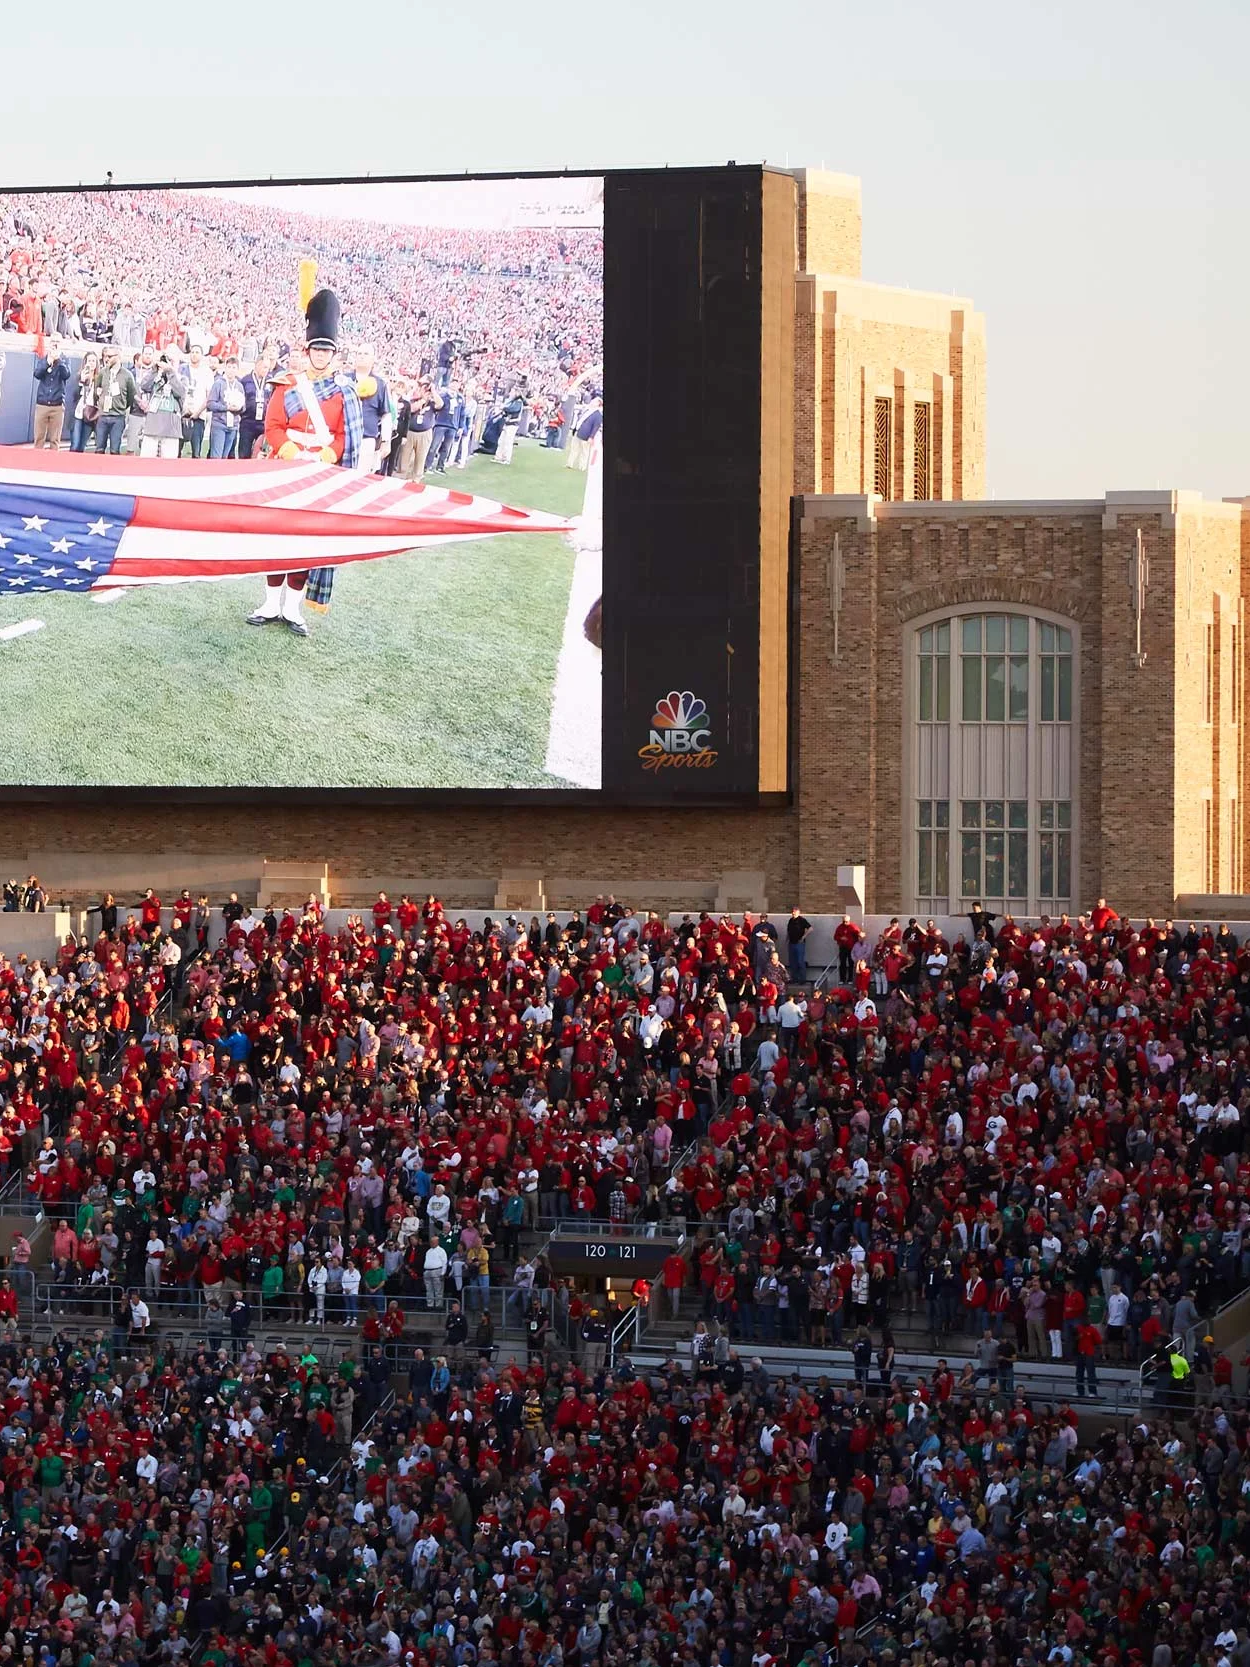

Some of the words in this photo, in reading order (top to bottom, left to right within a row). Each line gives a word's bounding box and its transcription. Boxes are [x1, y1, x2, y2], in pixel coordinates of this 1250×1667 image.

[650, 729, 712, 752] NBC
[638, 744, 718, 775] Sports
[585, 1244, 606, 1257] 120
[620, 1246, 636, 1258] 121
[831, 1532, 837, 1542] 9
